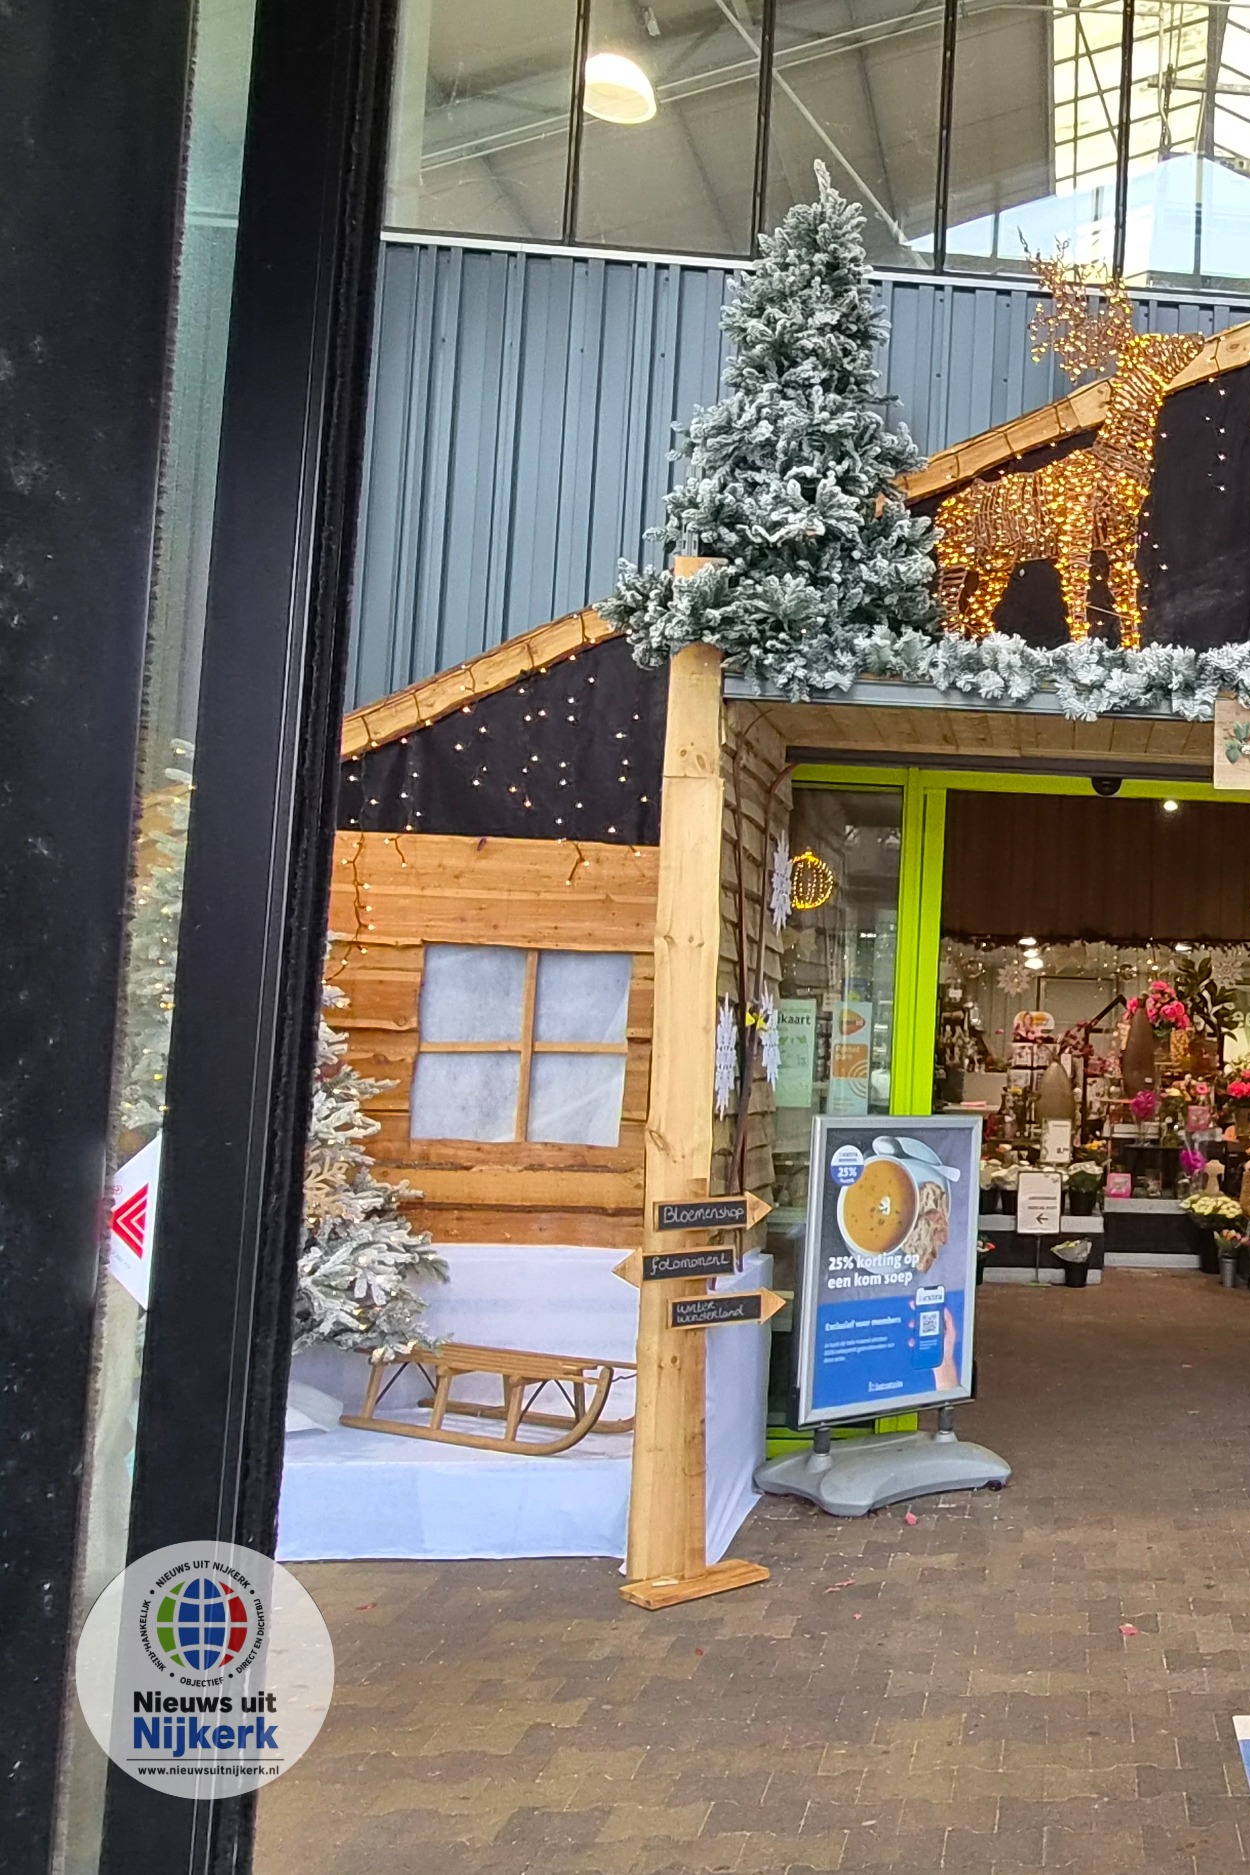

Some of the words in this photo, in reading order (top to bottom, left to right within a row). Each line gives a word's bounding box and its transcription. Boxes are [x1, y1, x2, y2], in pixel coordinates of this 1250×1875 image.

[828, 1255, 854, 1271] 25%
[856, 1254, 901, 1270] korting
[904, 1253, 920, 1267] op
[828, 1276, 851, 1289] een
[854, 1272, 881, 1287] kom
[884, 1270, 913, 1285] soep
